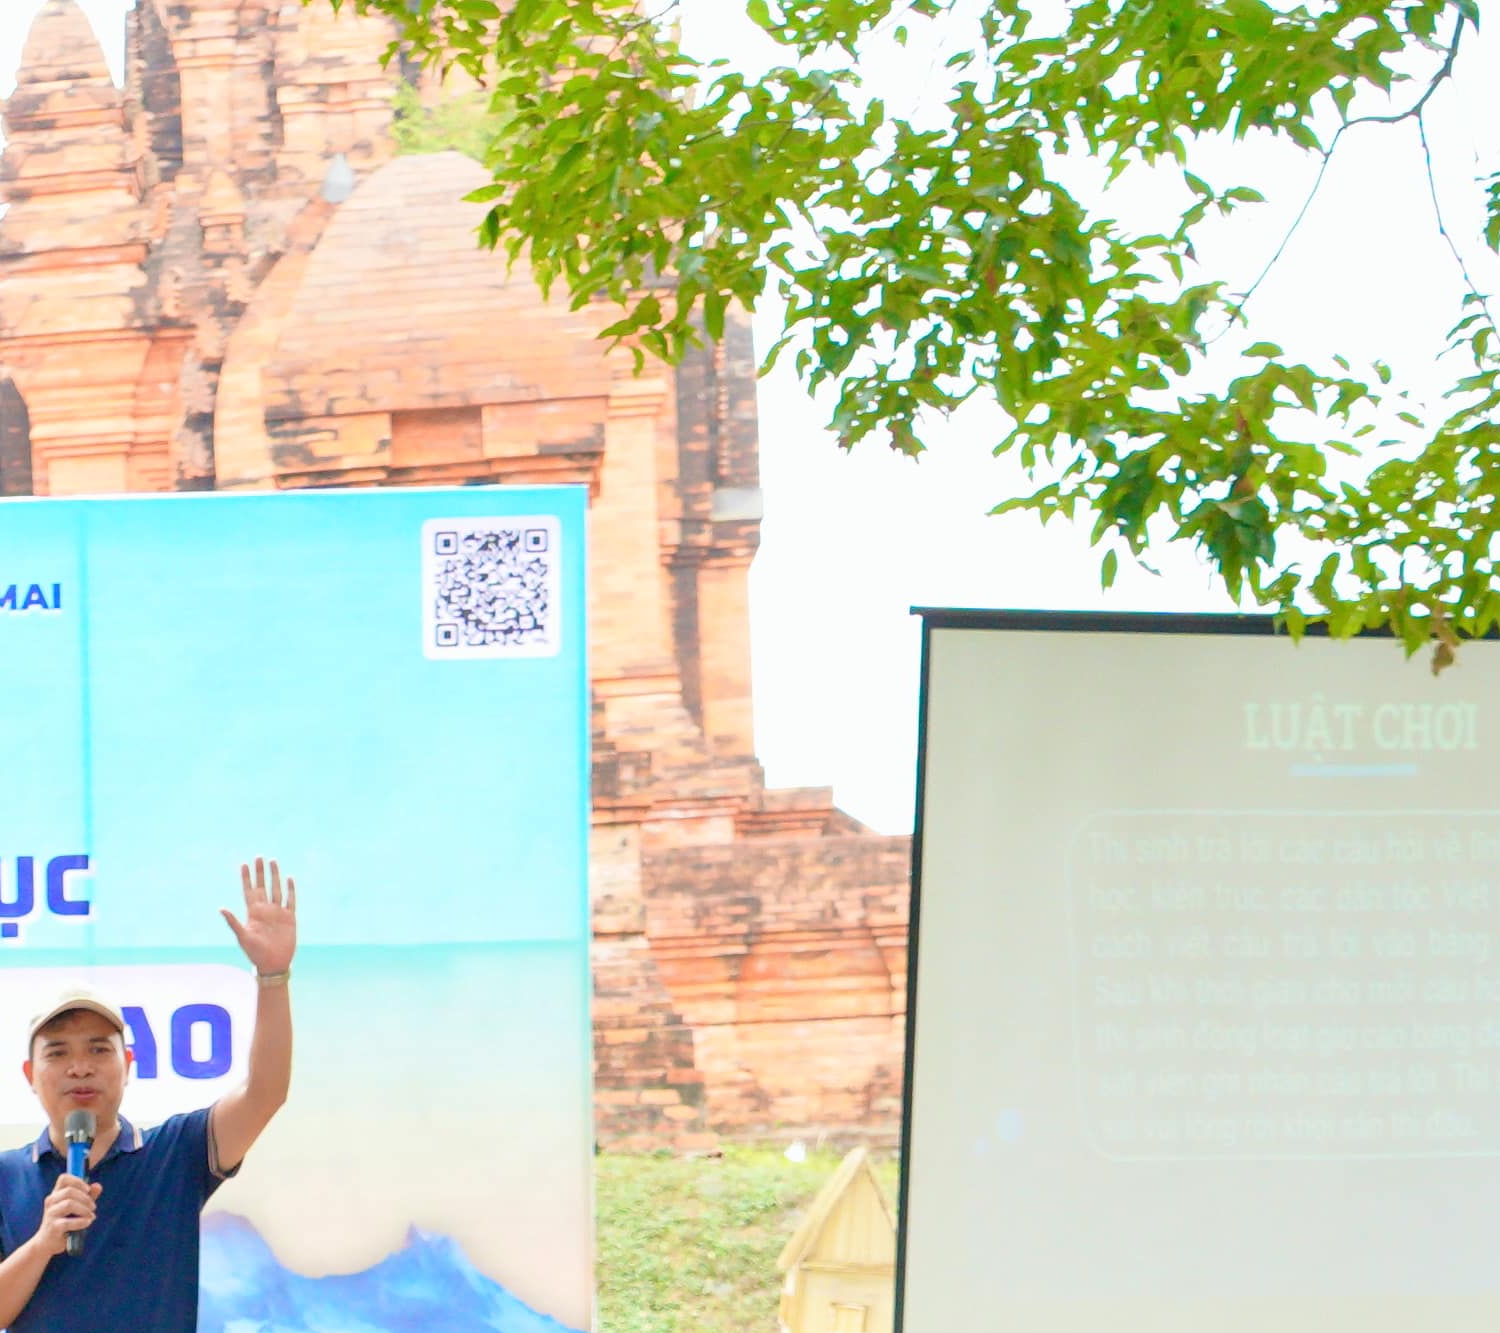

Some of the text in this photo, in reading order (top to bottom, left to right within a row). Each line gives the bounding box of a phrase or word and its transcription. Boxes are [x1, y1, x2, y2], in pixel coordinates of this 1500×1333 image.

[1241, 690, 1480, 763] LUẬT CHƠI
[120, 1003, 232, 1080] AO
